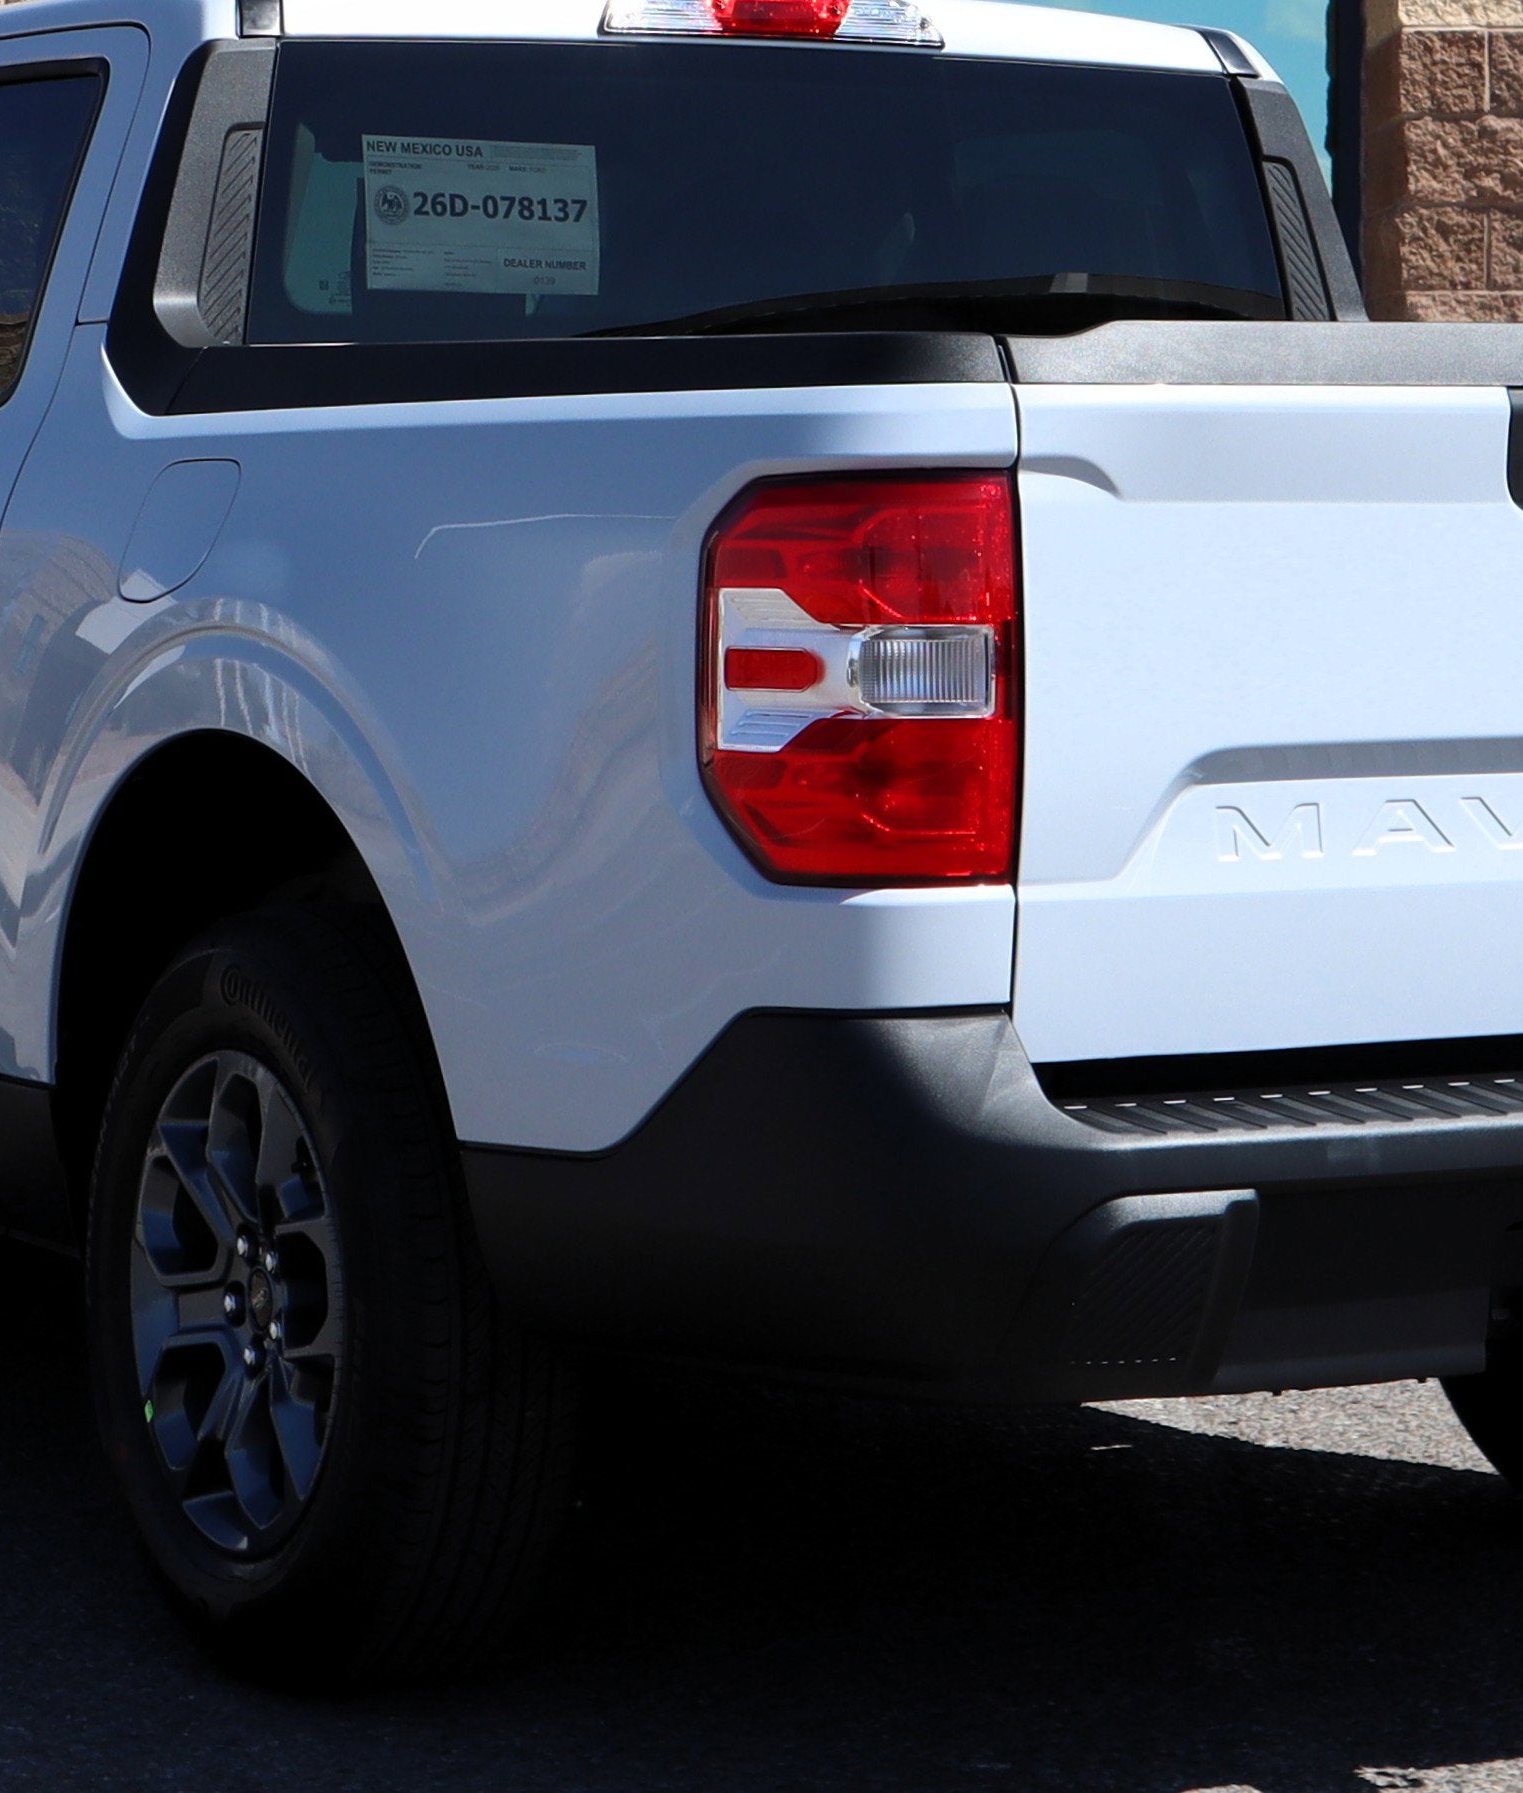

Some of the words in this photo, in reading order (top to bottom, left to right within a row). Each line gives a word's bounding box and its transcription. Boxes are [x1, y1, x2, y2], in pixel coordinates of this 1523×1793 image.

[365, 140, 397, 153] NEW
[400, 142, 453, 156] MEXICO
[455, 145, 484, 158] USA
[412, 191, 588, 223] 26D-078137
[503, 258, 543, 269] DEALER
[544, 260, 587, 271] NUMBER
